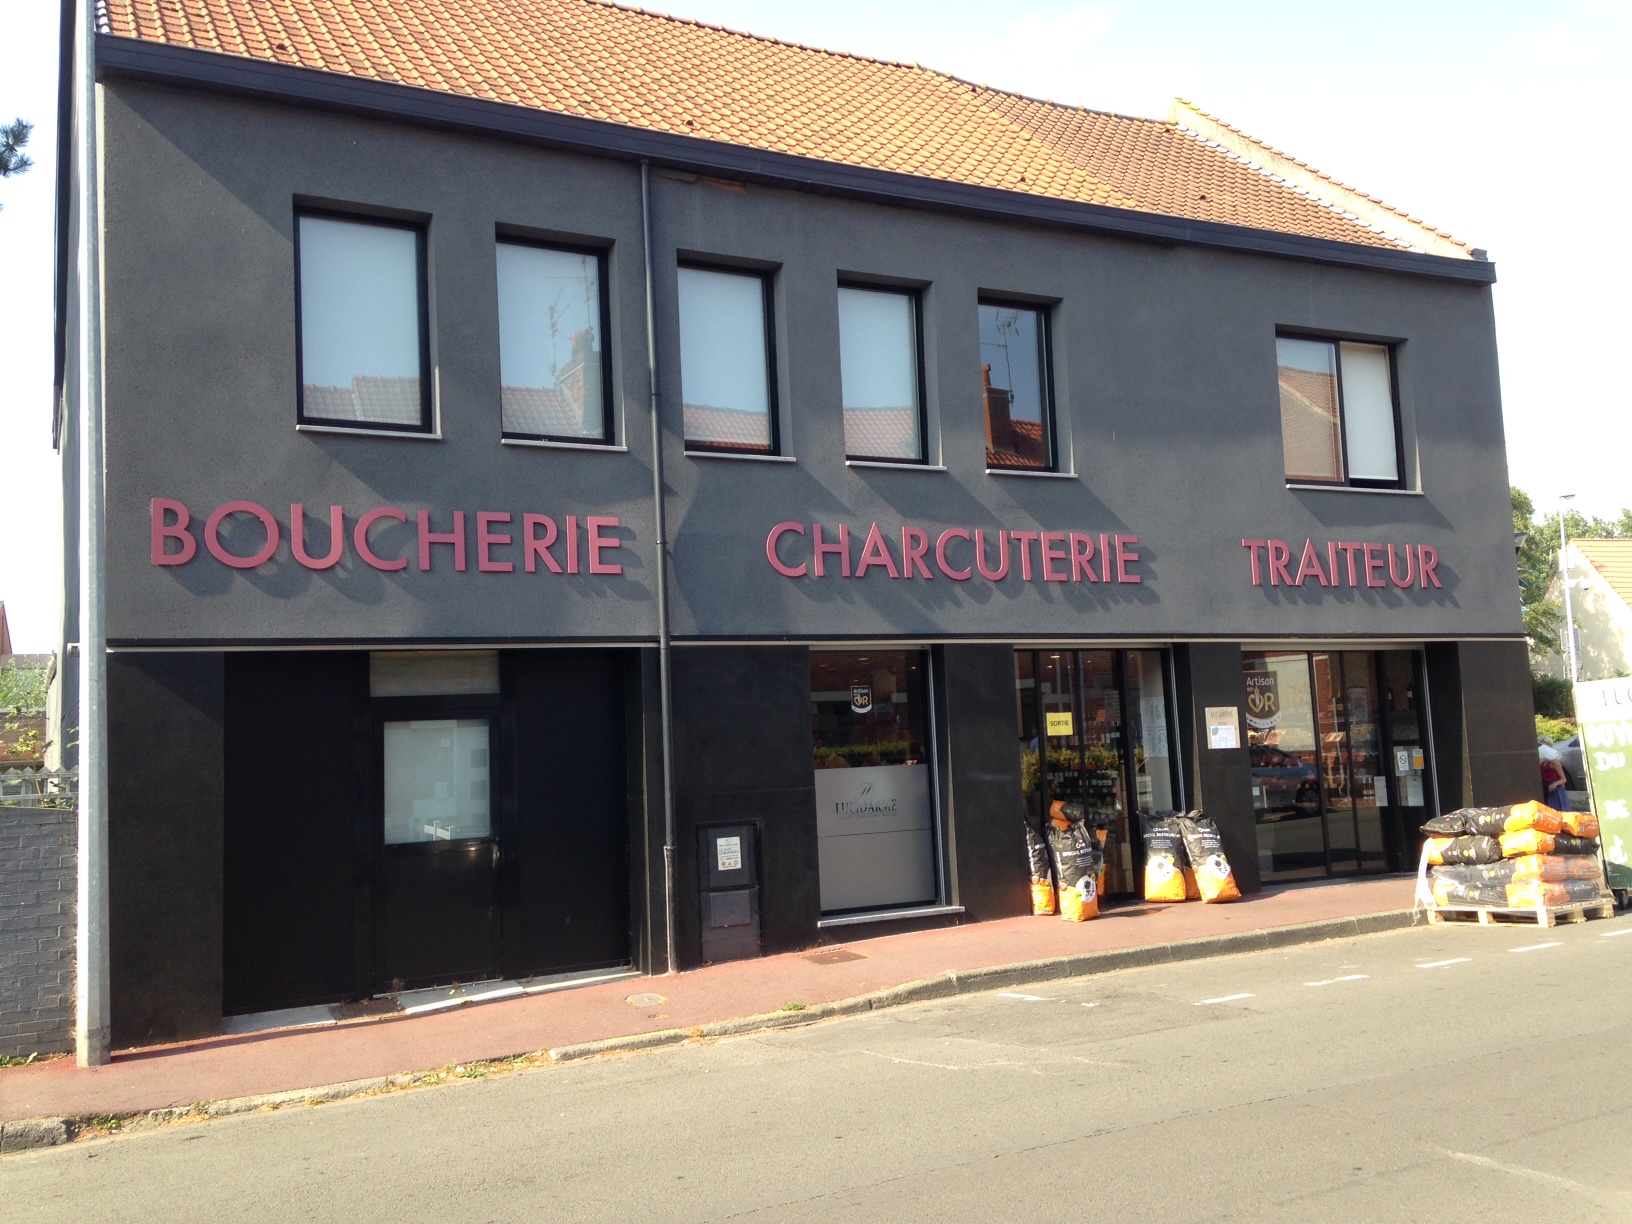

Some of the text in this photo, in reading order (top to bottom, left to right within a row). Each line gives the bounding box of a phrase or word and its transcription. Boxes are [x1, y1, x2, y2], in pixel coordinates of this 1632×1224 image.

[150, 497, 623, 576] BOUCHERIE
[765, 520, 1142, 584] CHARCUTERIE
[1241, 537, 1444, 590] TRAITEUR
[1246, 676, 1274, 686] Artisan
[1050, 719, 1069, 727] SORTIE
[1593, 751, 1626, 772] DU
